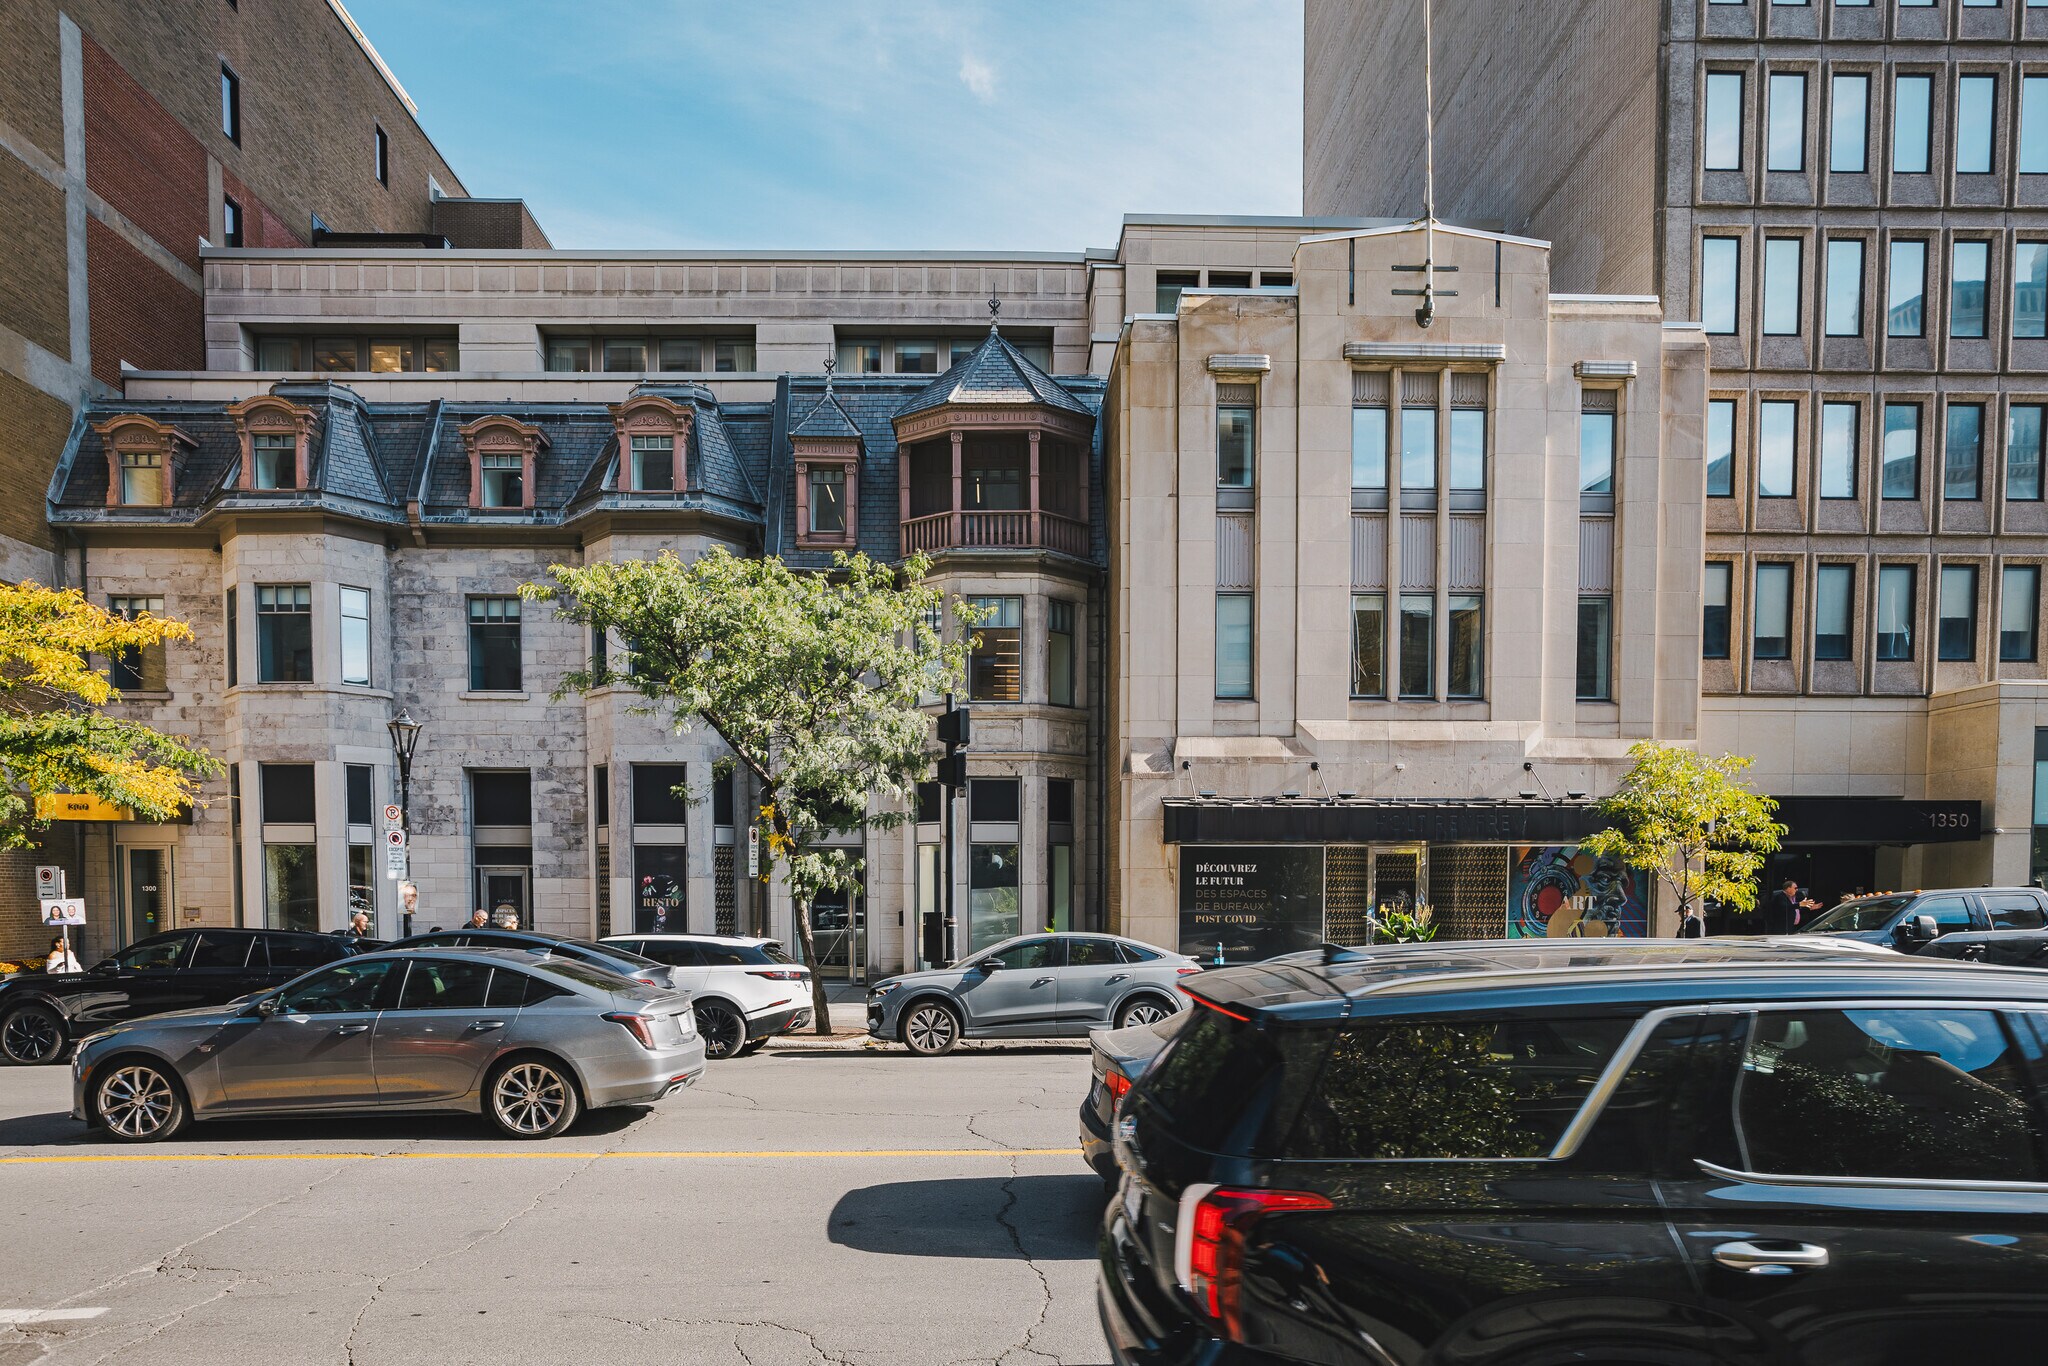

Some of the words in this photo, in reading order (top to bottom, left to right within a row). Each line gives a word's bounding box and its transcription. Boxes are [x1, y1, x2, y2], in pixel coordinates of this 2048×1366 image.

[1929, 813, 1969, 827] 1350
[1196, 863, 1257, 873] DÉCOUVREZ
[1196, 877, 1208, 885] LE
[1210, 877, 1244, 885] FUTUR
[1196, 890, 1217, 898] DES
[1220, 890, 1267, 898] ESPACES
[643, 898, 679, 907] RESTO
[1196, 902, 1210, 910] DE
[1213, 902, 1264, 910] BUREAUX
[1562, 895, 1597, 910] ART
[1195, 915, 1221, 923] POST
[1225, 915, 1257, 923] COVID
